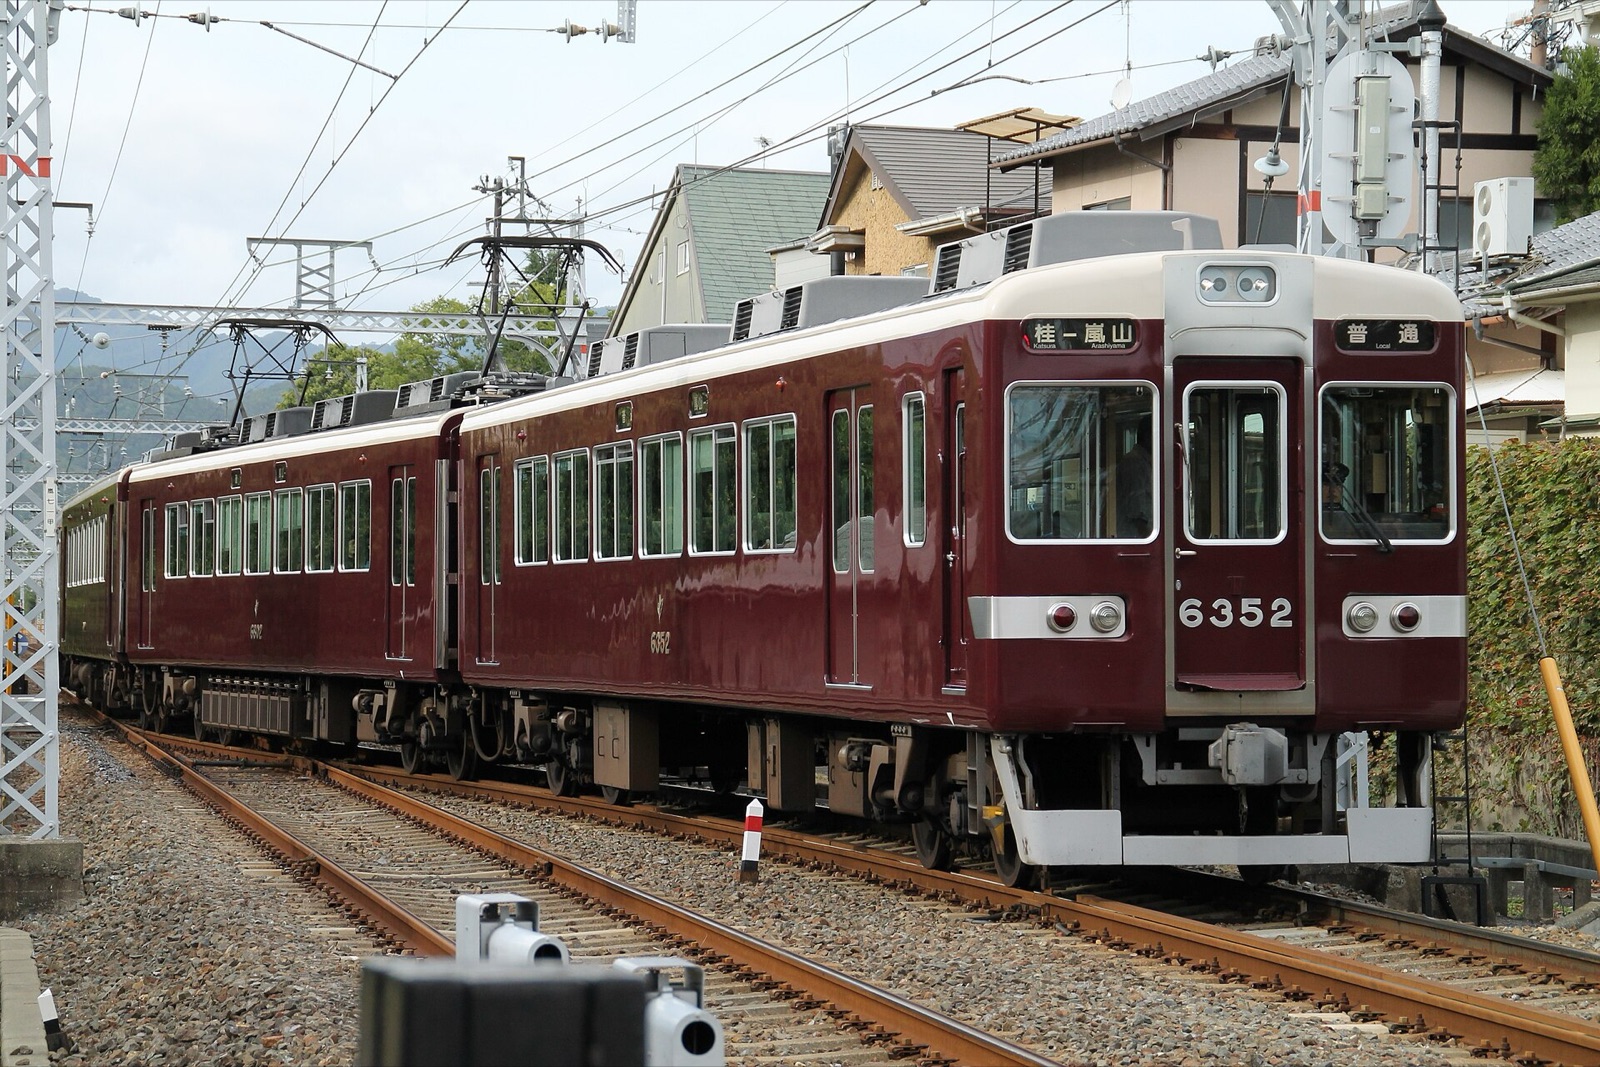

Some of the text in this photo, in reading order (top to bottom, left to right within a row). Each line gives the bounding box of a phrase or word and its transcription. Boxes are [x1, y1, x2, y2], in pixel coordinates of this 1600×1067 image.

[1347, 323, 1420, 344] 普通
[1091, 342, 1126, 350] Arashiyama
[1179, 597, 1293, 628] 6352
[650, 631, 671, 655] 6352
